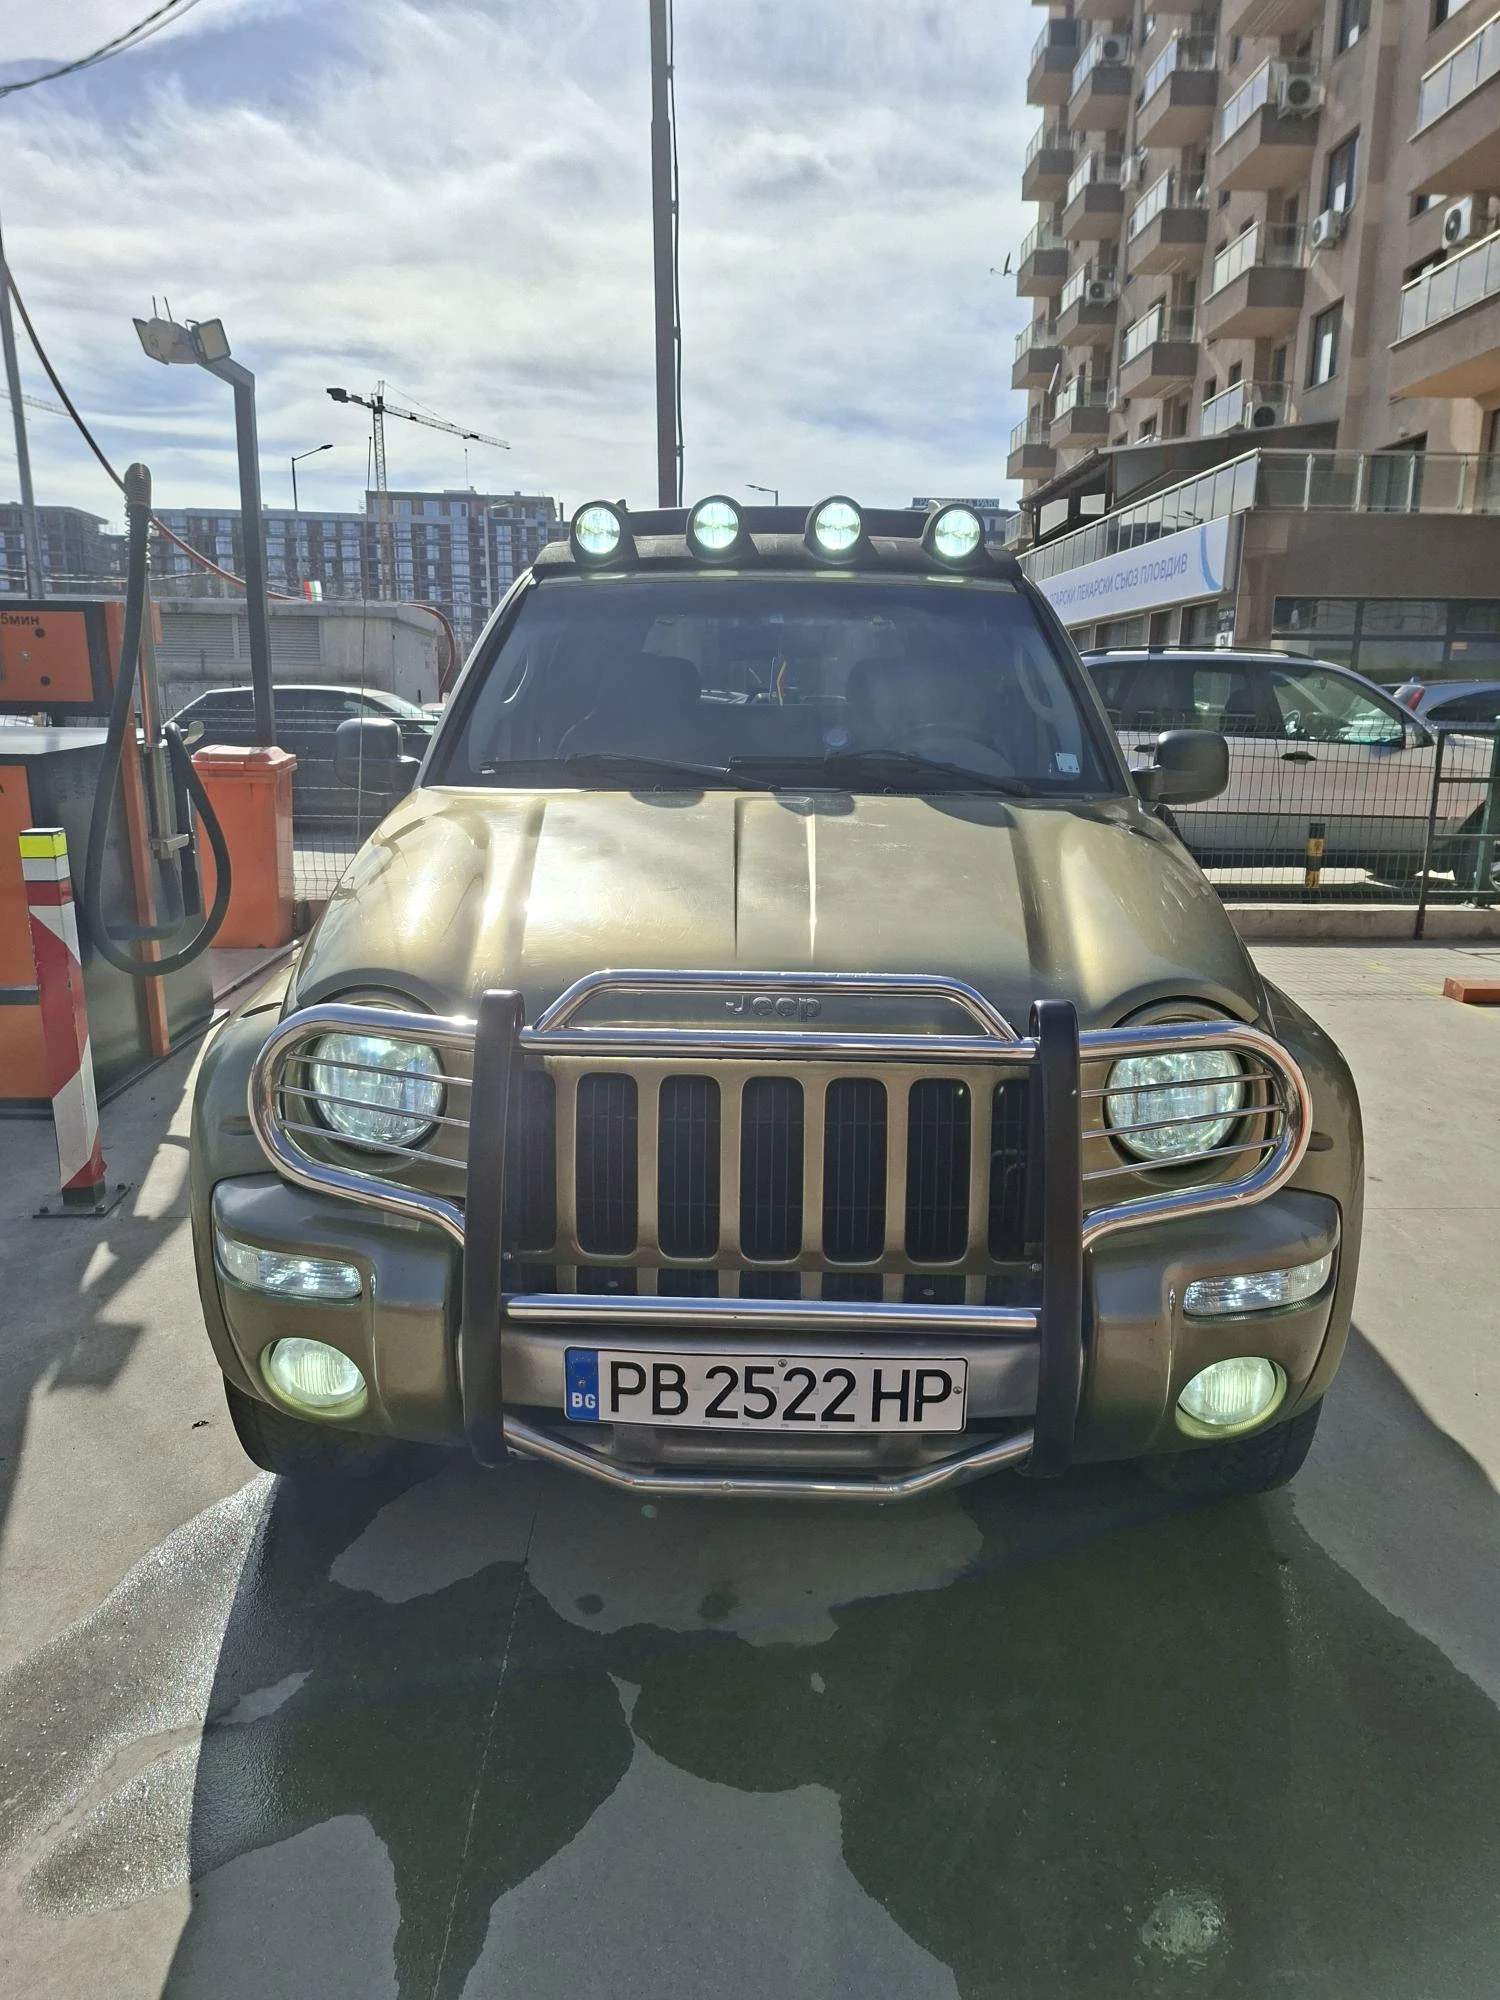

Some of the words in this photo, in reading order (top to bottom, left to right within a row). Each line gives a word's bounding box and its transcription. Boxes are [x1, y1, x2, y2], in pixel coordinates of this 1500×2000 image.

[1114, 568, 1139, 591] СЪЮЗ
[1140, 553, 1189, 585] ПЛОВДИВ
[725, 994, 821, 1022] Jeep
[571, 1391, 596, 1409] BG
[610, 1360, 689, 1416] PB
[704, 1364, 857, 1423] 2522
[871, 1368, 953, 1423] HP
